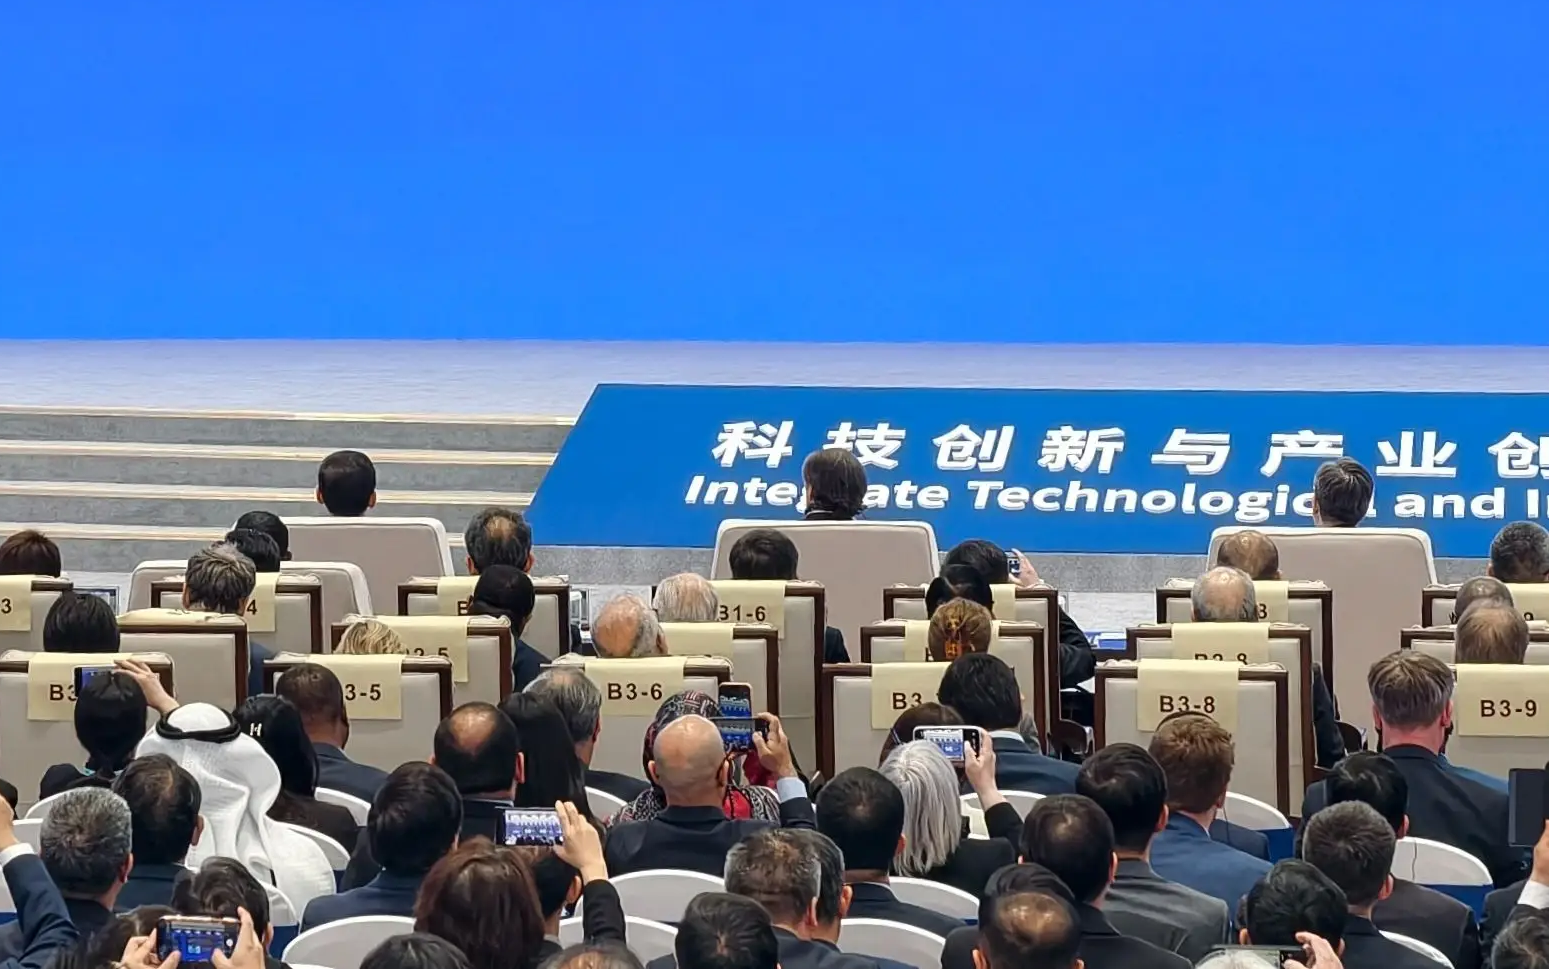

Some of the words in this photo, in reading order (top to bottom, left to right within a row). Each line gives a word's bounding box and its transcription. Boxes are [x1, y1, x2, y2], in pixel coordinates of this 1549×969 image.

[684, 475, 950, 514] Inteate
[1394, 487, 1506, 520] and
[607, 682, 663, 701] B3-6
[1159, 695, 1216, 714] B3-8
[1480, 699, 1538, 718] B3-9
